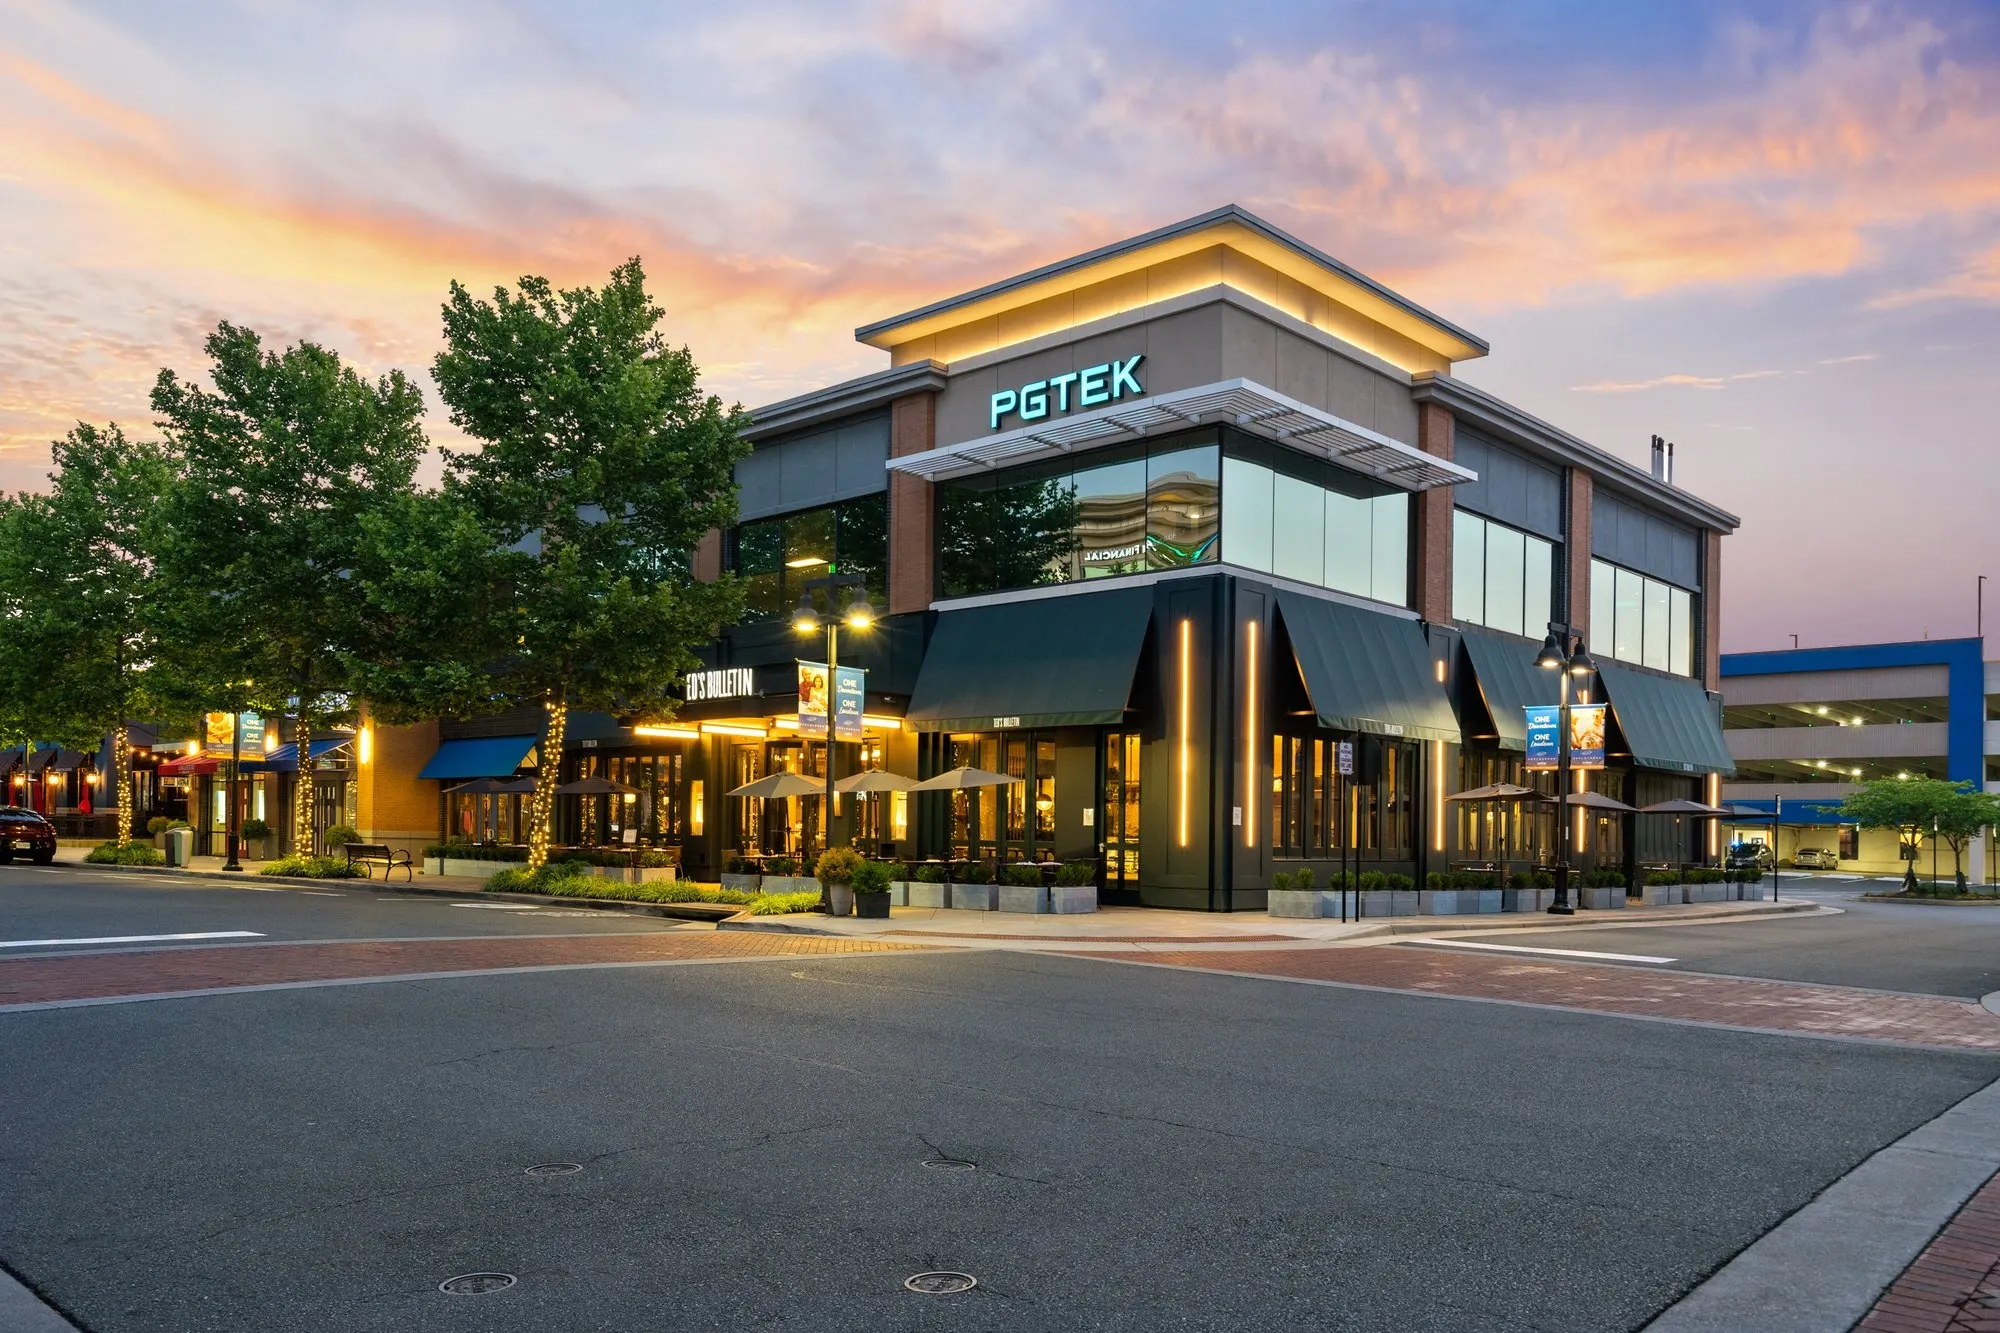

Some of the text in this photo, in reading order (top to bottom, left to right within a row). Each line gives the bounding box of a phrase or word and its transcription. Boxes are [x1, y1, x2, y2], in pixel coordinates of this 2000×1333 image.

[991, 354, 1145, 429] PGTEK
[686, 668, 753, 701] ED'S BULLETIN
[843, 679, 857, 687] ONE
[843, 700, 857, 708] ONE
